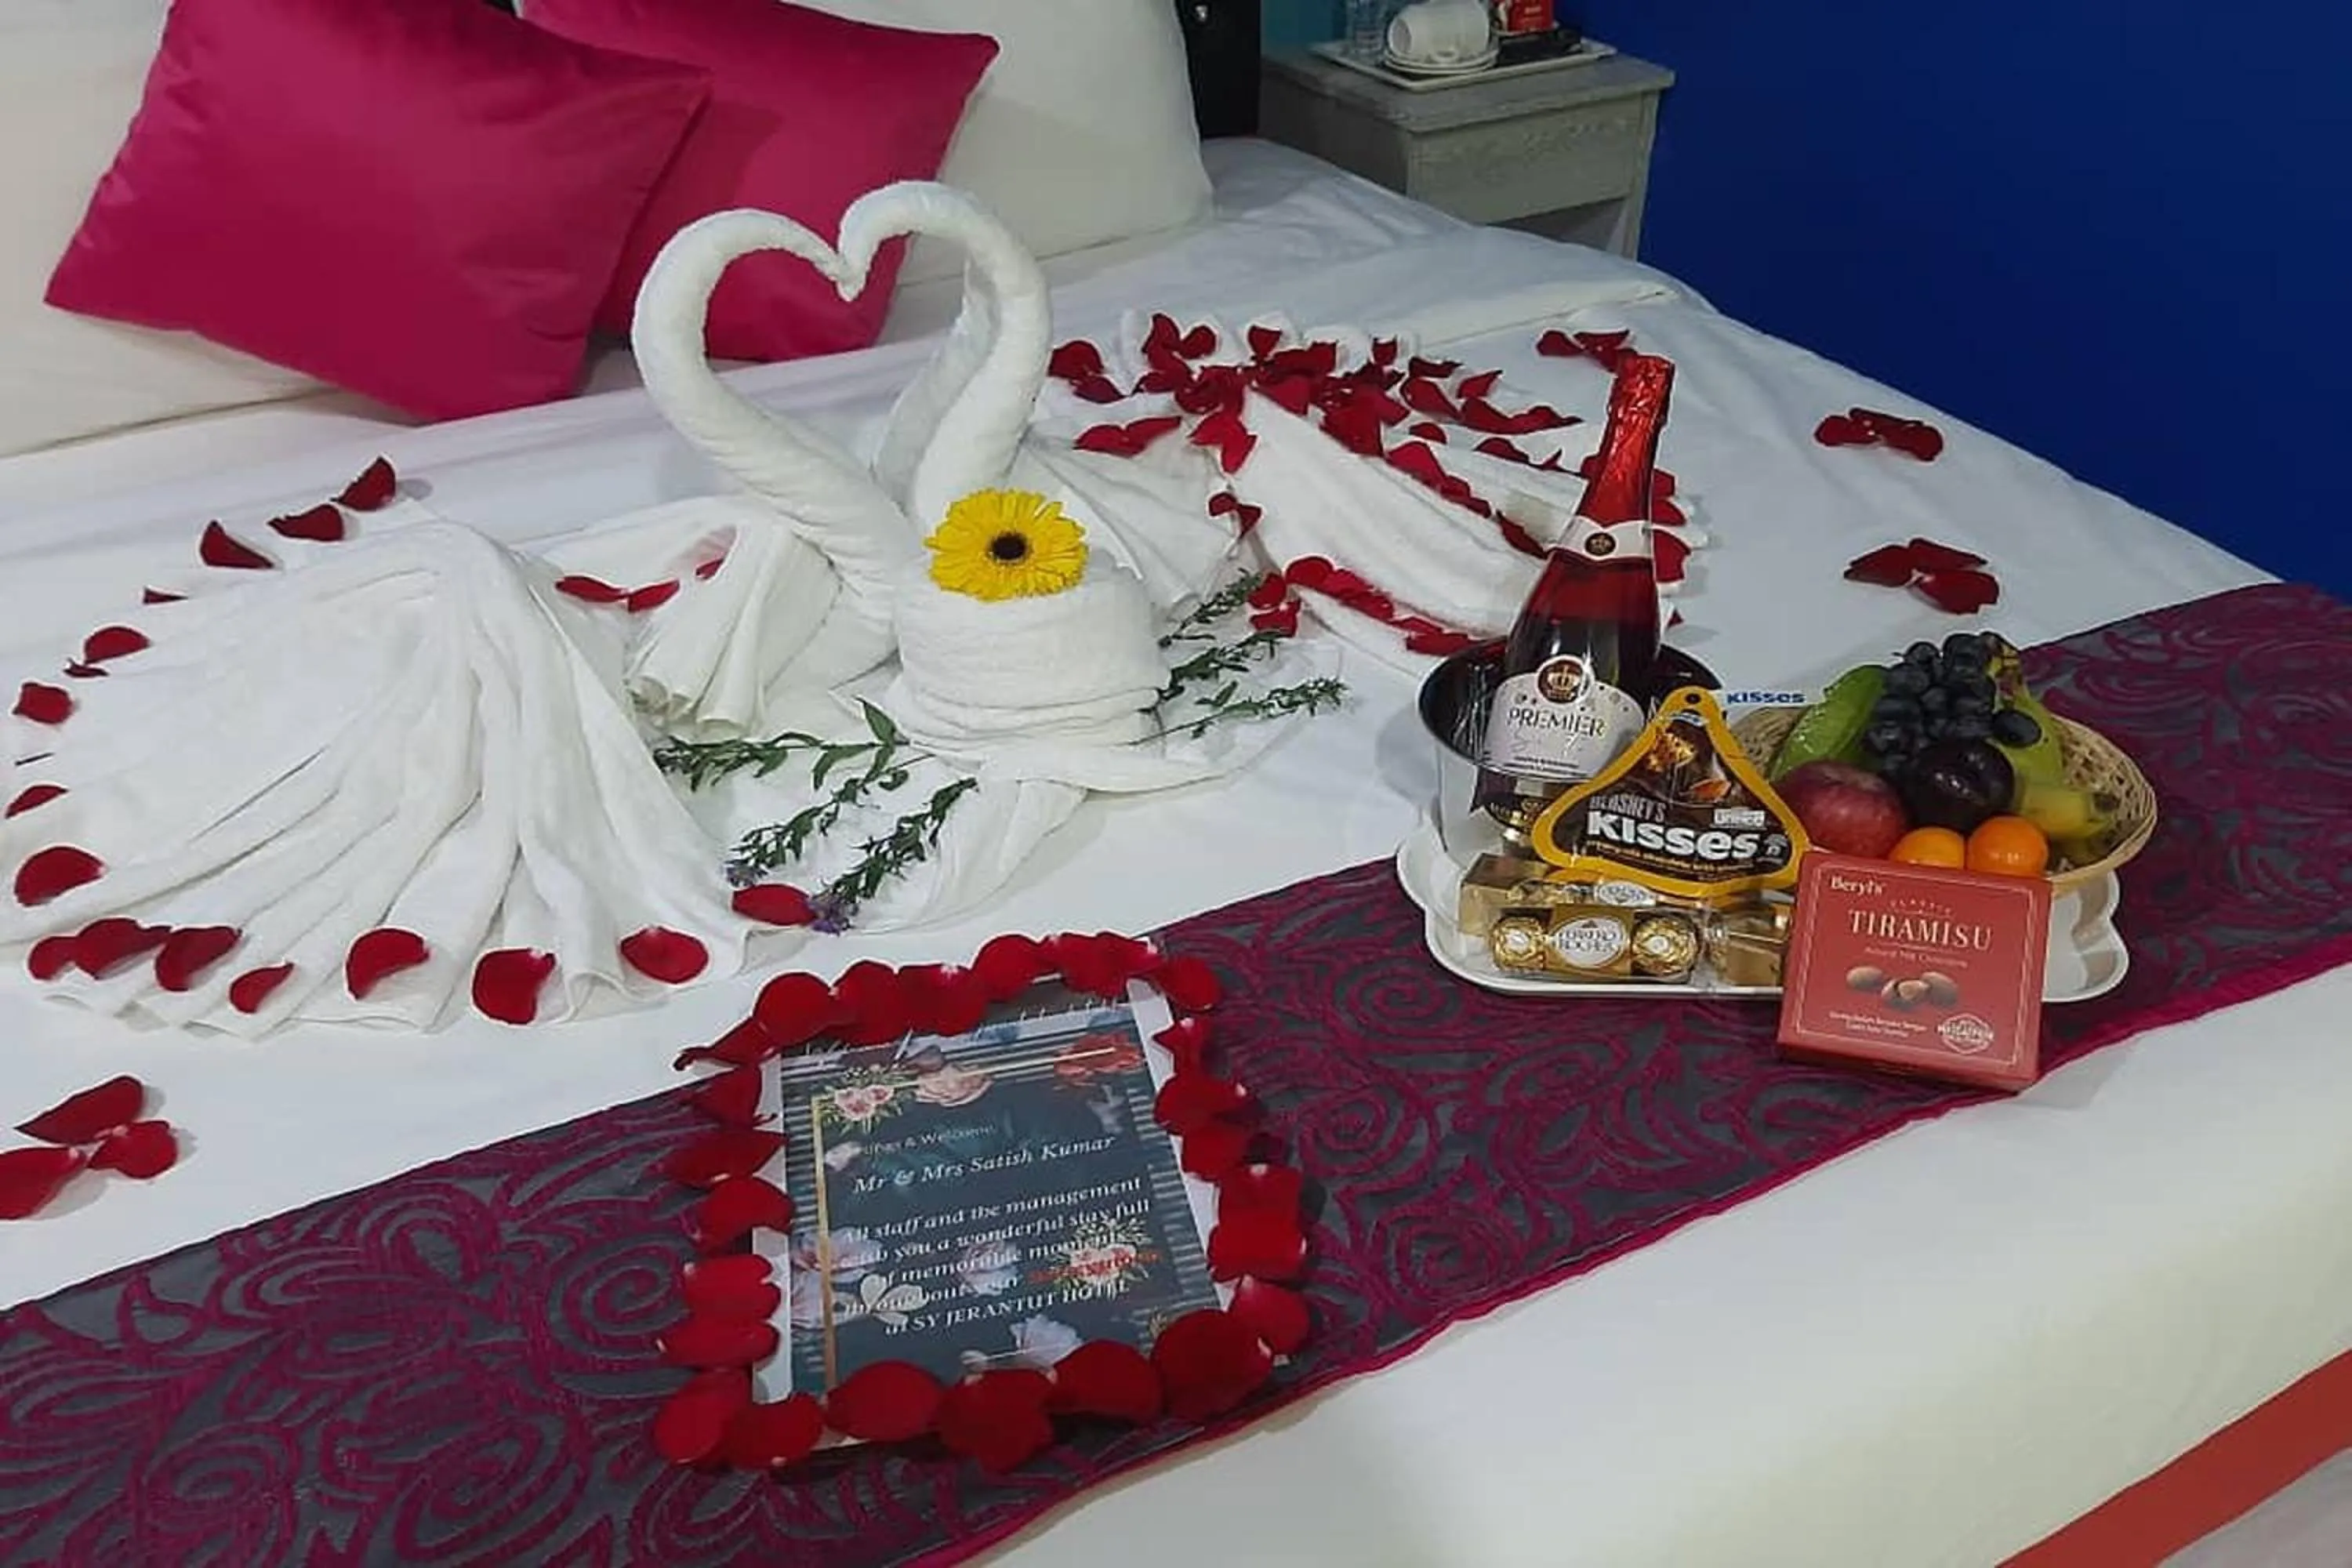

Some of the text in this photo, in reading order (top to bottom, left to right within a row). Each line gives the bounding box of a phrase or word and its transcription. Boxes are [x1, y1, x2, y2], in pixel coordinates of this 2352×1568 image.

[1508, 706, 1606, 737] PREMIER
[1831, 875, 1884, 896] Beryl's
[1848, 908, 1993, 951] TIRAMISU
[852, 1137, 1116, 1194] Mr & Mrs Satish Kumar
[874, 1215, 924, 1236] staff
[924, 1209, 964, 1229] and
[971, 1204, 1008, 1220] the
[1006, 1177, 1141, 1214] management
[894, 1241, 933, 1262] you
[938, 1238, 950, 1250] a
[956, 1214, 1065, 1248] wonderful
[1069, 1210, 1111, 1227] stay
[1116, 1198, 1150, 1221] full
[912, 1312, 941, 1331] SY
[946, 1290, 1058, 1327] JERANTUT
